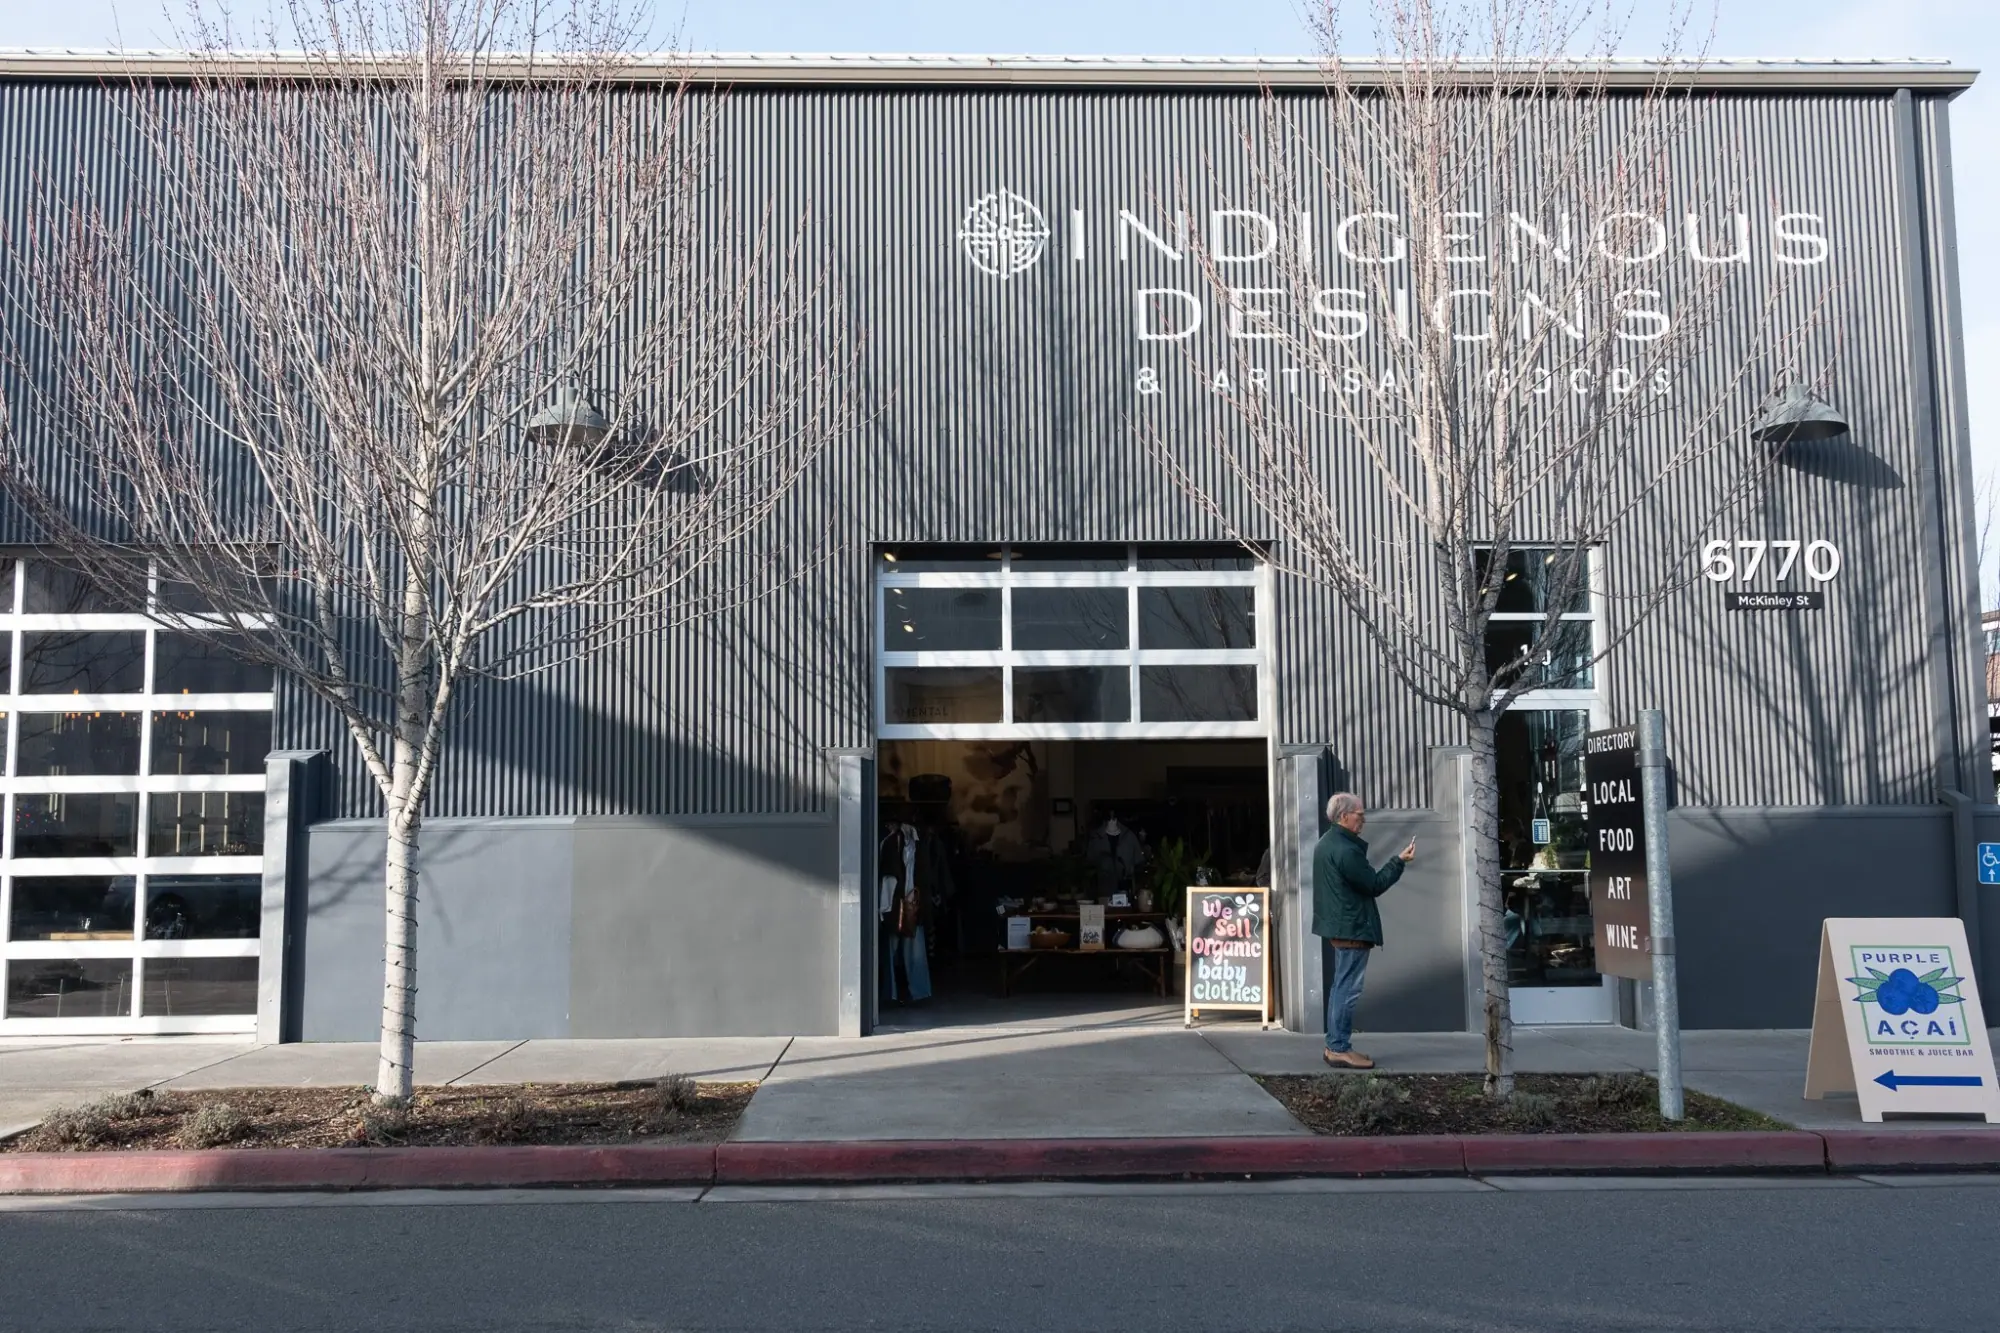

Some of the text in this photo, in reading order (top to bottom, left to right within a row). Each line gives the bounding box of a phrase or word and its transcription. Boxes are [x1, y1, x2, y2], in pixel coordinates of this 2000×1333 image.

[1074, 208, 1829, 266] INDIGENOUS
[1137, 287, 1671, 341] DESIGNS
[1137, 366, 1162, 395] &
[1211, 368, 1441, 397] ARTISA
[1702, 539, 1841, 582] 6770
[1738, 595, 1810, 607] McKinley St
[1587, 730, 1636, 754] DIRECTORY
[1593, 778, 1636, 805] LOCAL
[1599, 828, 1635, 852] FOOD
[1608, 876, 1632, 900] ART
[1202, 899, 1233, 920] We
[1215, 918, 1252, 938] Sell
[1606, 923, 1639, 949] WINE
[1192, 937, 1262, 965] organic
[1862, 953, 1941, 963] PURPLE
[1198, 957, 1247, 988] baby
[1193, 980, 1261, 1003] clothes
[1869, 1048, 1915, 1056] SMOOTHIE
[1956, 1049, 1974, 1057] BAR
